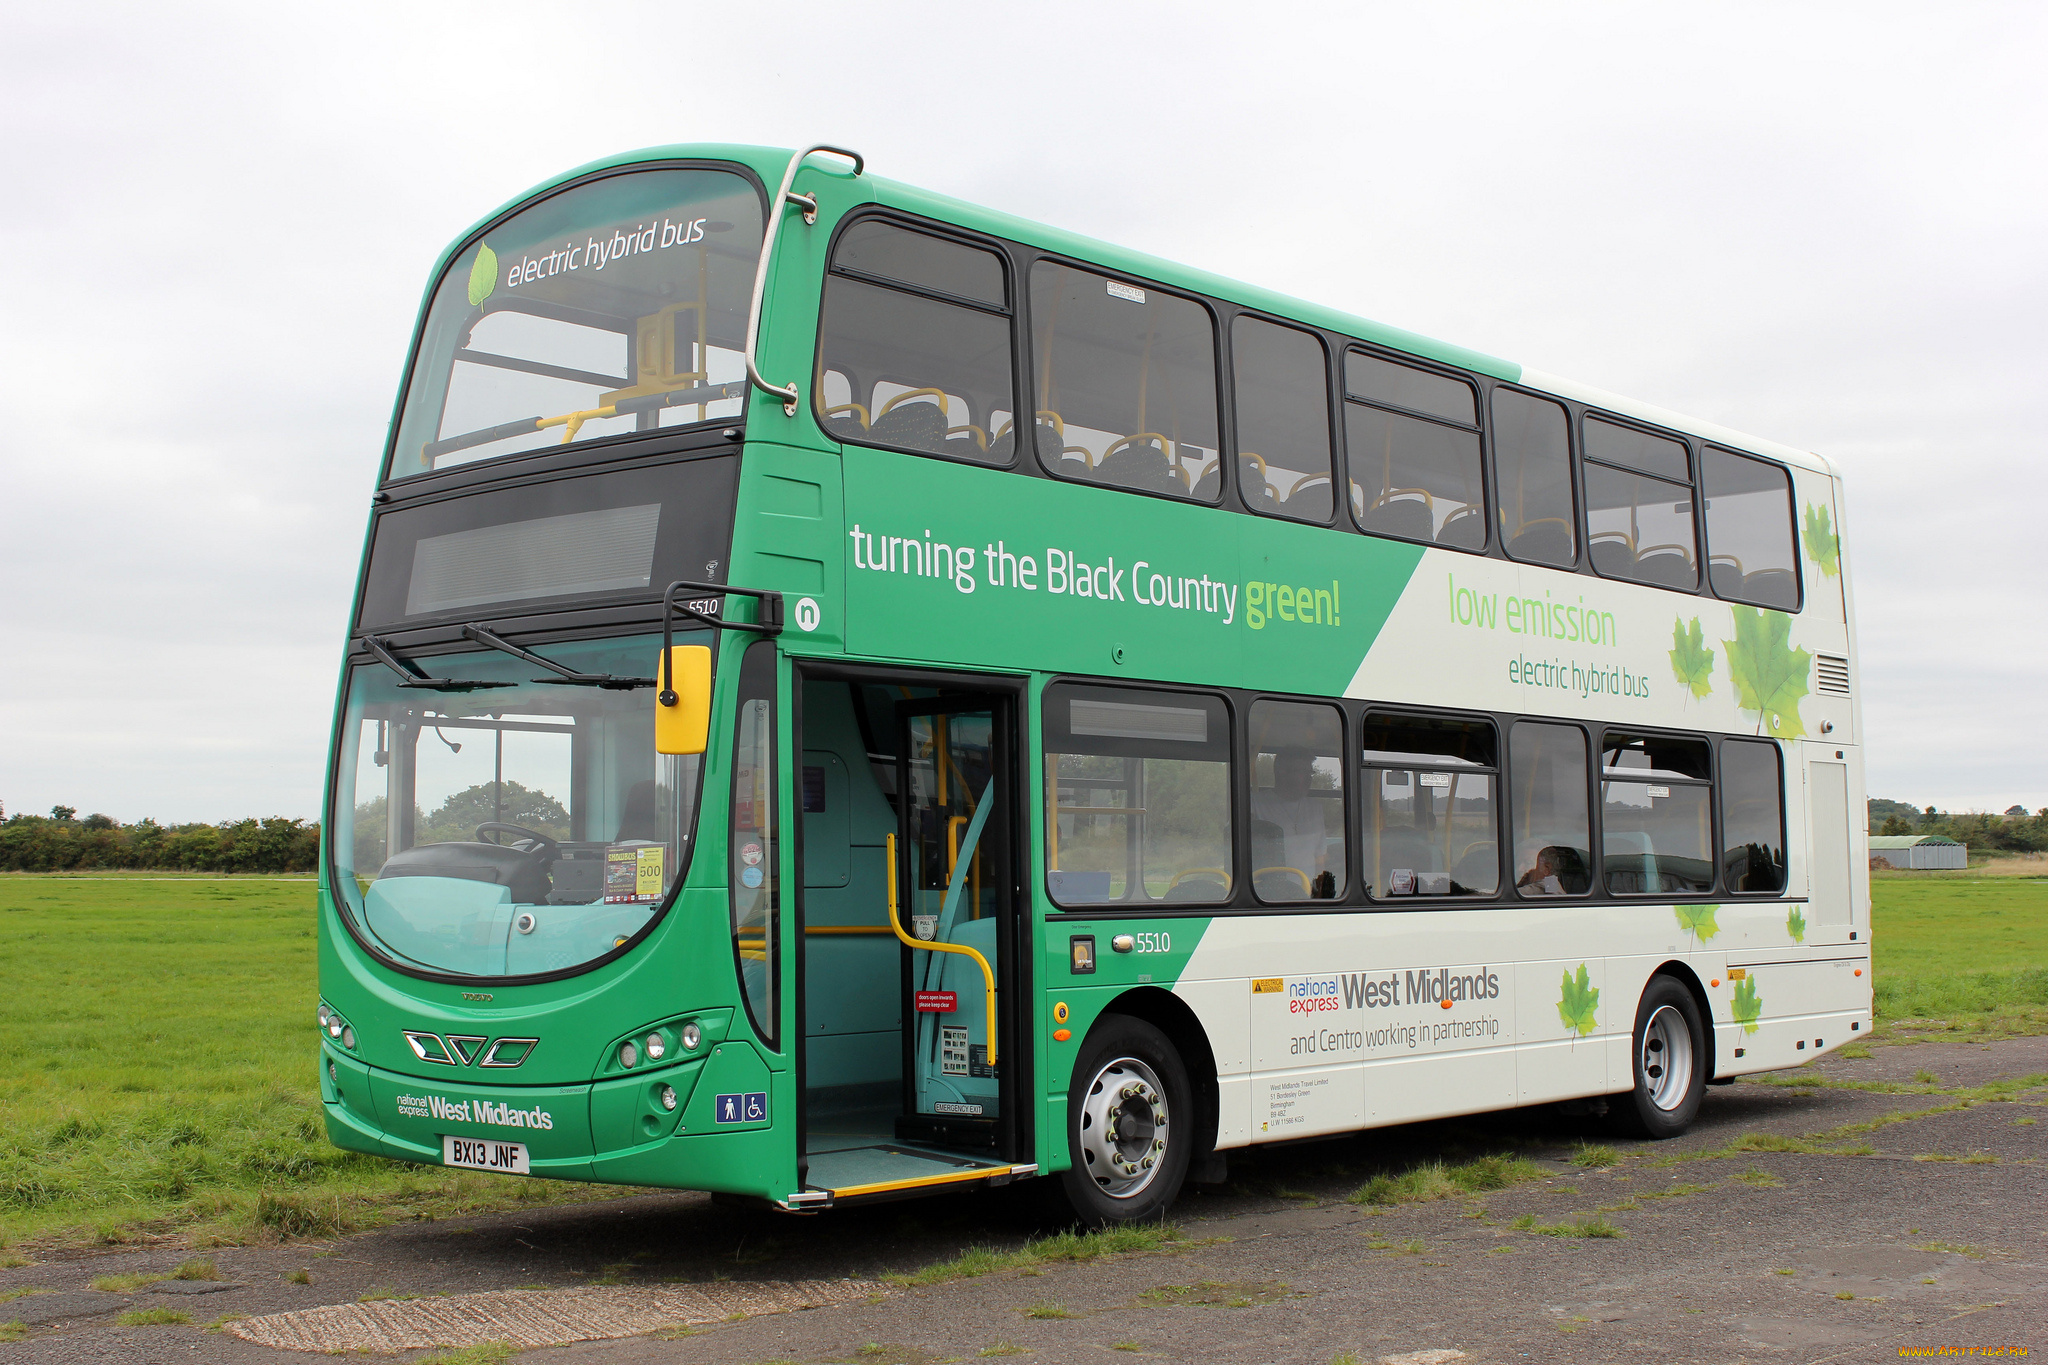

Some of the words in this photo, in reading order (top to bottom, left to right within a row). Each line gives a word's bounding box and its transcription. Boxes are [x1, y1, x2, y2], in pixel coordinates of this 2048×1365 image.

[507, 242, 582, 288] electric
[584, 221, 657, 271] hybrid
[660, 218, 707, 249] bus
[849, 524, 976, 594] turning
[983, 540, 1038, 590] the
[1047, 548, 1125, 602] Black
[1132, 561, 1237, 624] Country
[1245, 580, 1341, 630] green!
[1449, 573, 1497, 629] low
[1505, 590, 1616, 647] emission
[1509, 653, 1568, 689] electric
[1571, 660, 1619, 699] hybrid
[1623, 666, 1649, 698] bus
[640, 865, 661, 877] 500
[1137, 932, 1171, 953] 5510
[461, 992, 493, 1002] VOLVO
[1261, 978, 1283, 987] ELECTRICAL
[1290, 976, 1338, 997] national
[1342, 973, 1400, 1010] West
[1405, 966, 1499, 1004] Midlands
[1290, 997, 1339, 1017] express
[1291, 1030, 1315, 1055] and
[1320, 1029, 1362, 1052] Centro
[1366, 1023, 1416, 1048] working
[1419, 1020, 1430, 1042] in
[1433, 1014, 1499, 1046] partnership
[396, 1094, 428, 1107] national
[428, 1095, 472, 1122] West
[472, 1100, 553, 1130] Midlands
[398, 1105, 430, 1118] express
[936, 1103, 969, 1112] EMERGENCY
[969, 1105, 982, 1113] EXIT
[453, 1140, 486, 1165] BX13
[490, 1145, 519, 1169] JNF
